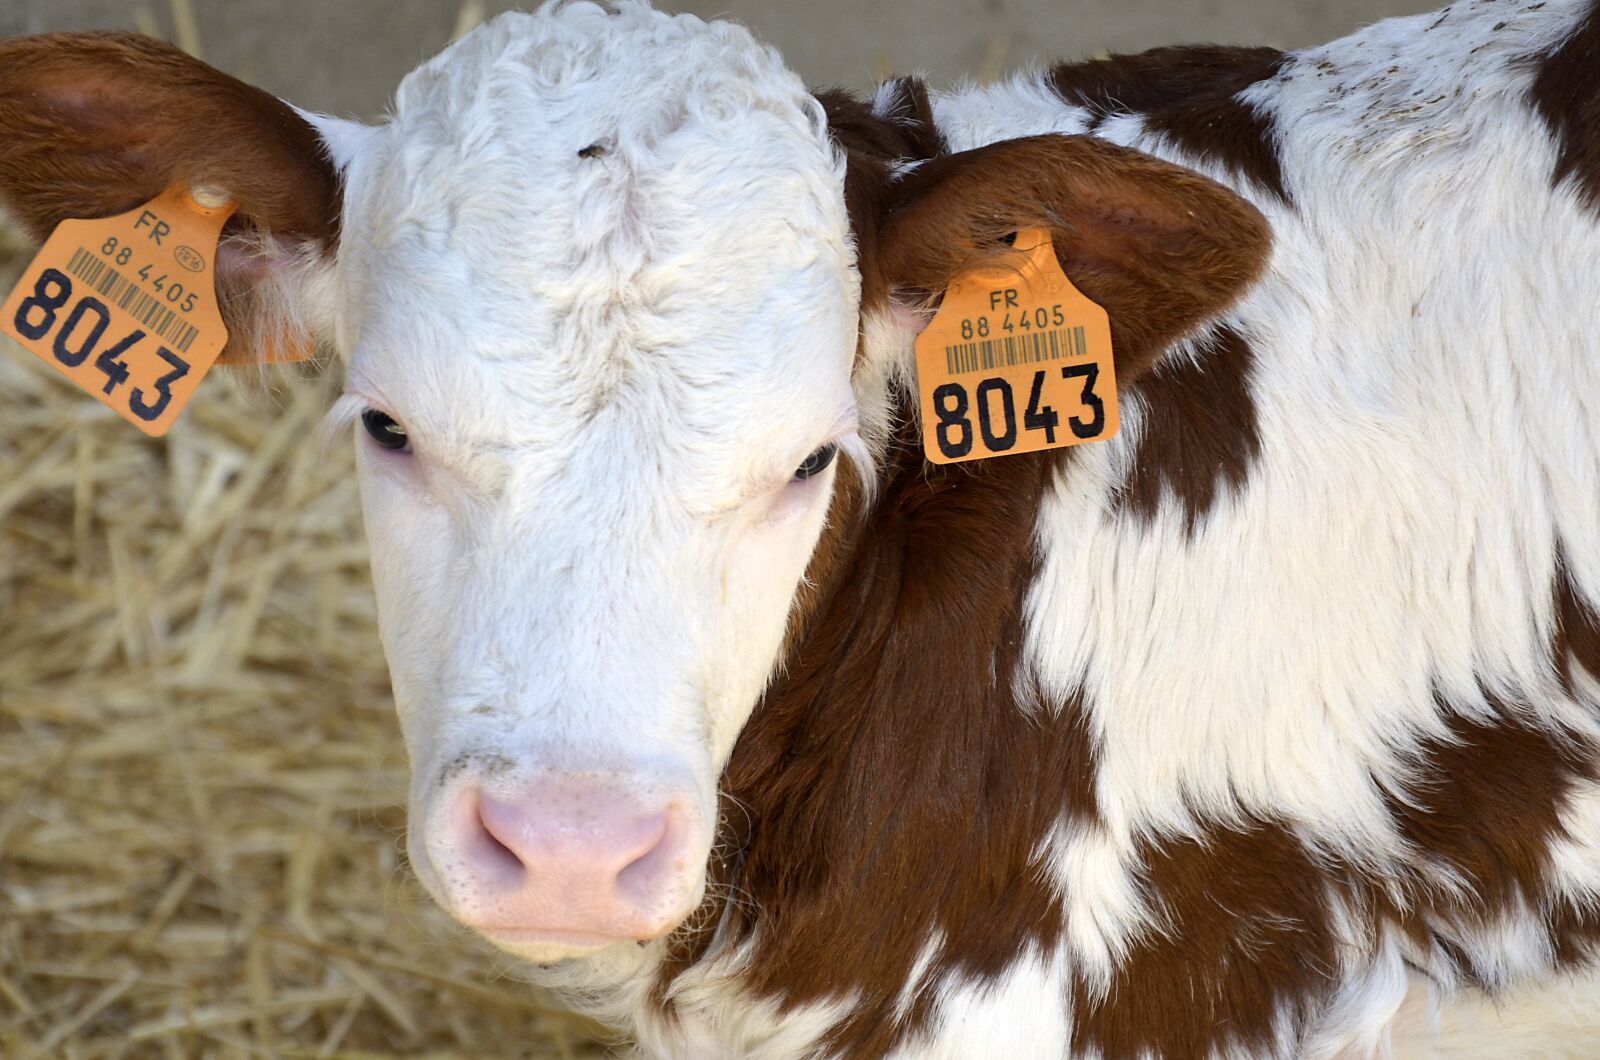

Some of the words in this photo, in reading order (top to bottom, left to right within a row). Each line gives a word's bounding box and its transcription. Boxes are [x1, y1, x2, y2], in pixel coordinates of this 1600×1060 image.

[133, 209, 171, 246] FR
[101, 237, 133, 266] 88
[138, 263, 199, 313] 4405
[989, 288, 1019, 311] FR
[13, 268, 191, 422] 8043
[961, 316, 990, 340] 88
[1002, 304, 1065, 333] 4405
[933, 362, 1105, 459] 8043
